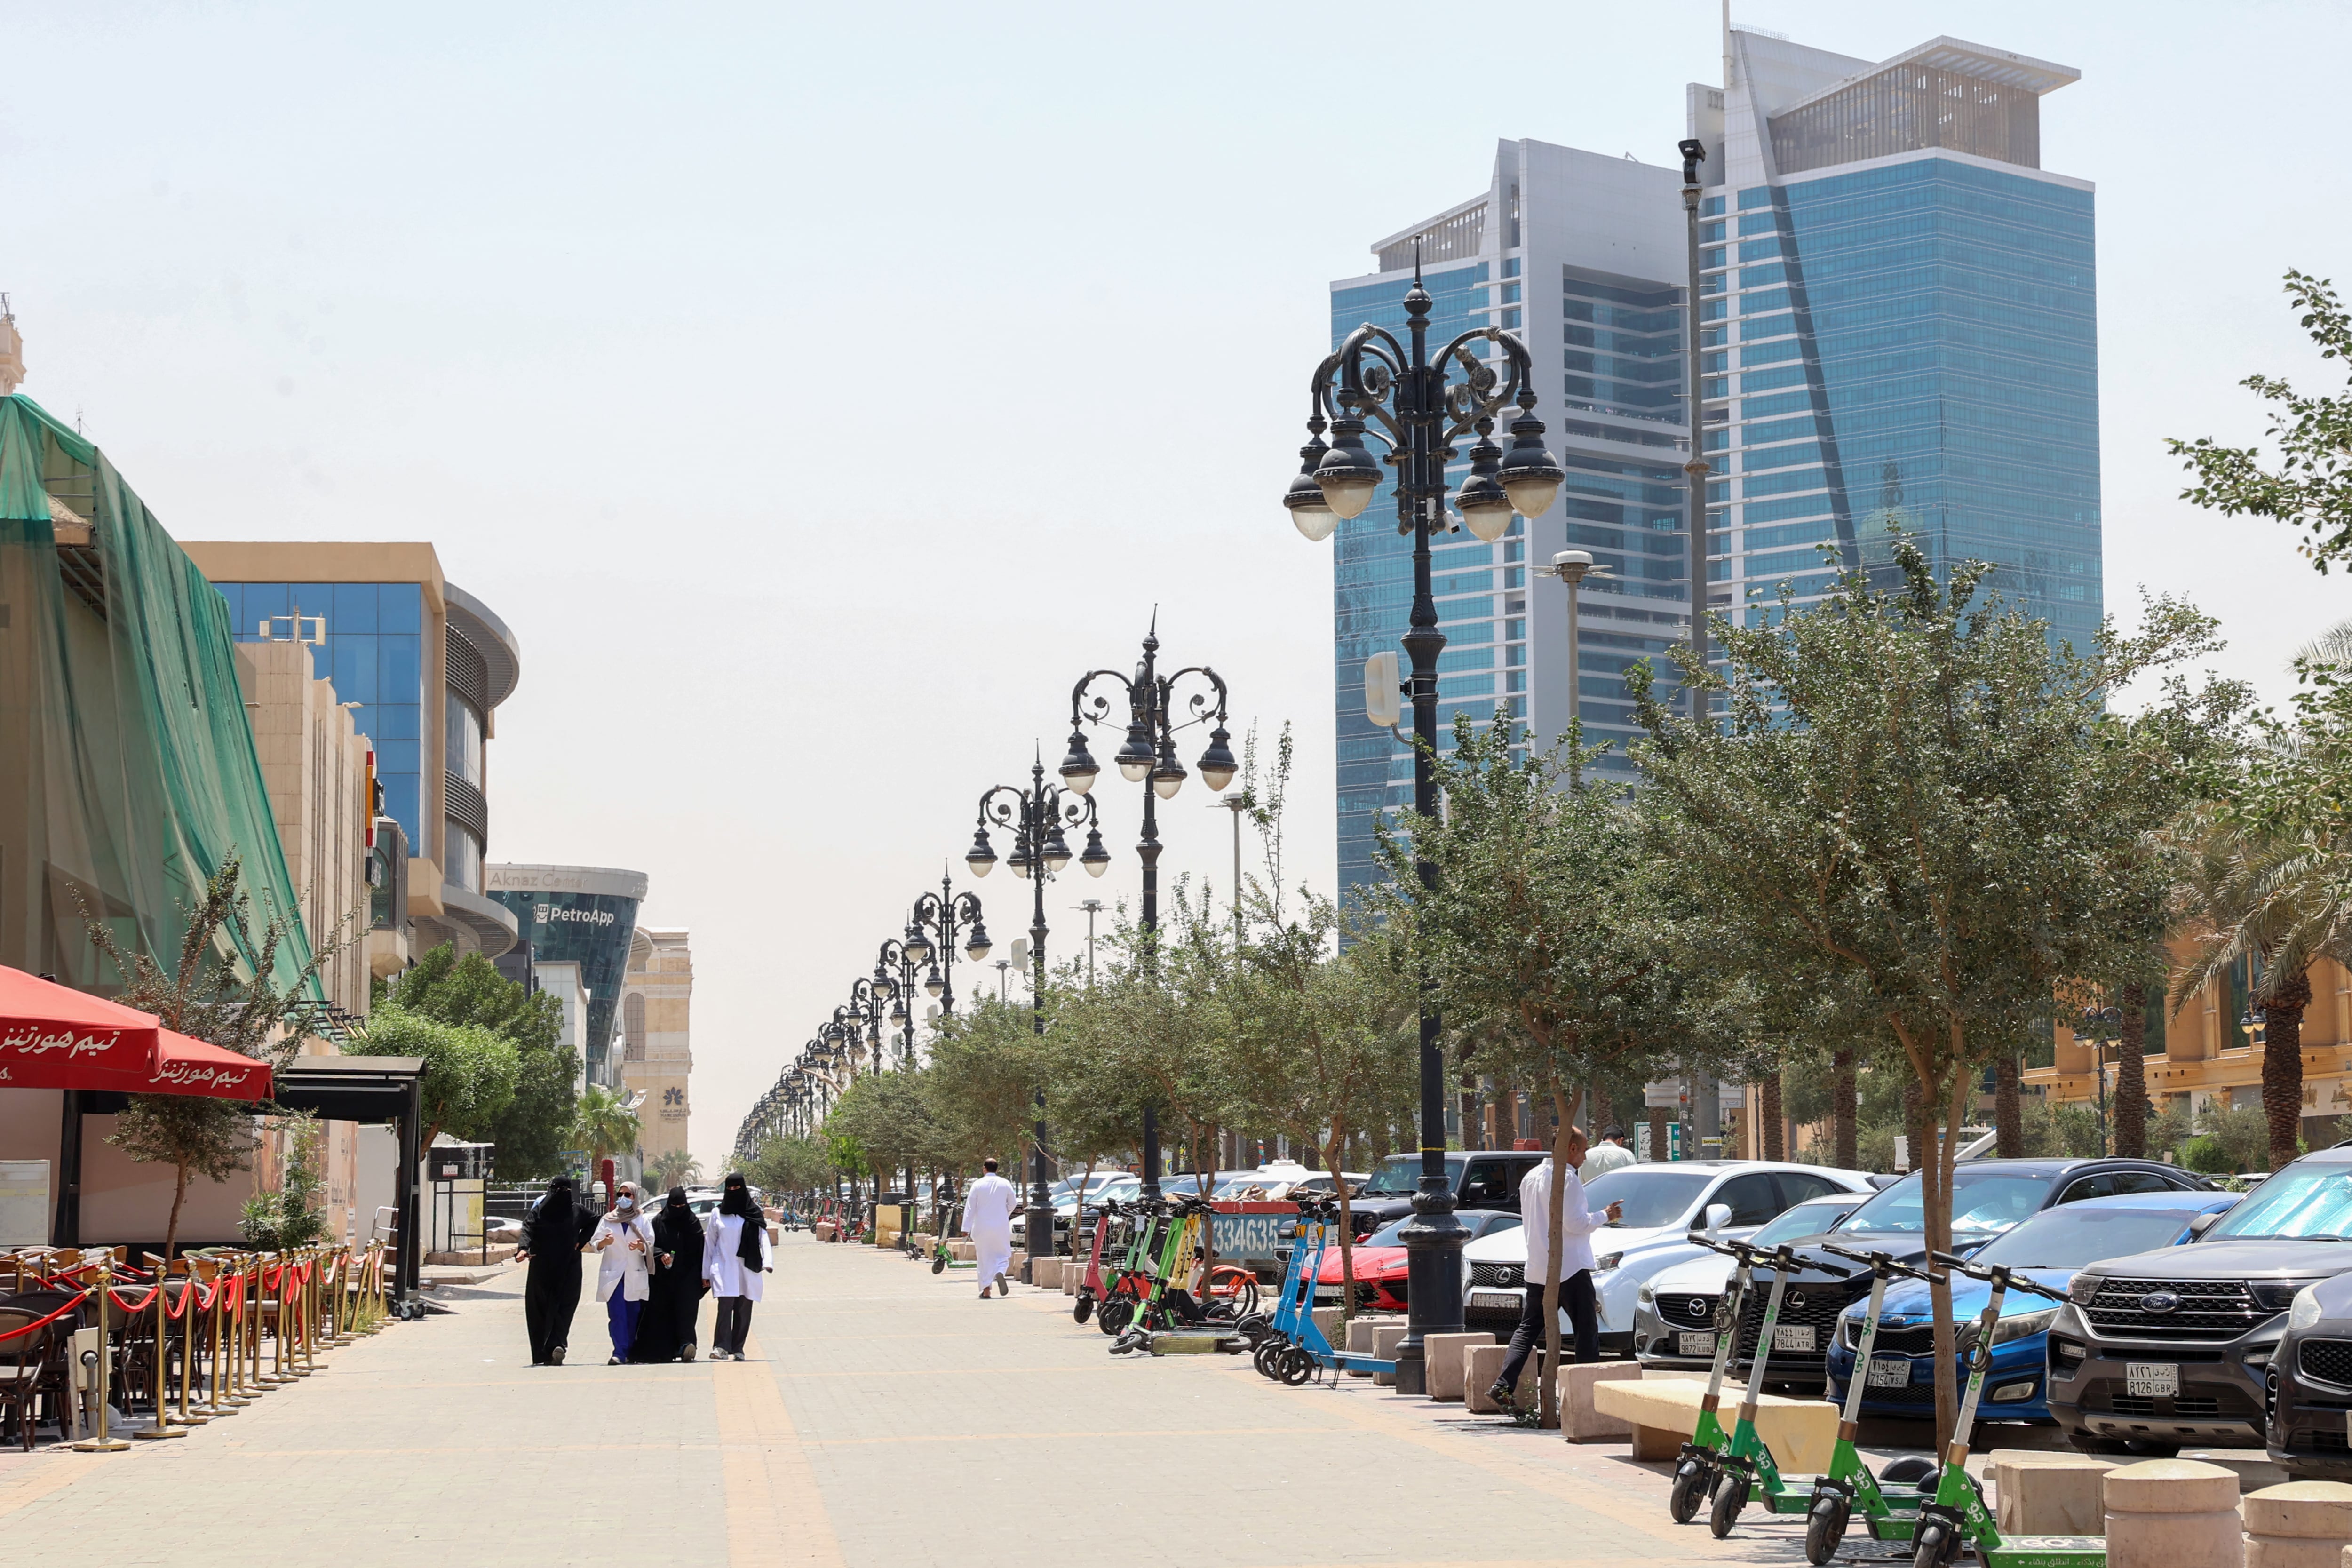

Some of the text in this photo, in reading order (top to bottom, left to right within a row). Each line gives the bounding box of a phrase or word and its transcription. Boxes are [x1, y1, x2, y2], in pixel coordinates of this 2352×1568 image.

[490, 872, 588, 888] Aknaz Center
[550, 907, 614, 926] PetroApp
[69, 1030, 121, 1059] تيم
[149, 1062, 250, 1089] تيم هورتنز
[2147, 1297, 2168, 1308] Ford
[1681, 1345, 1696, 1354] 9872
[1776, 1339, 1794, 1349] 7844
[1870, 1374, 1888, 1386] 7154
[2130, 1381, 2171, 1394] 8126 GBR
